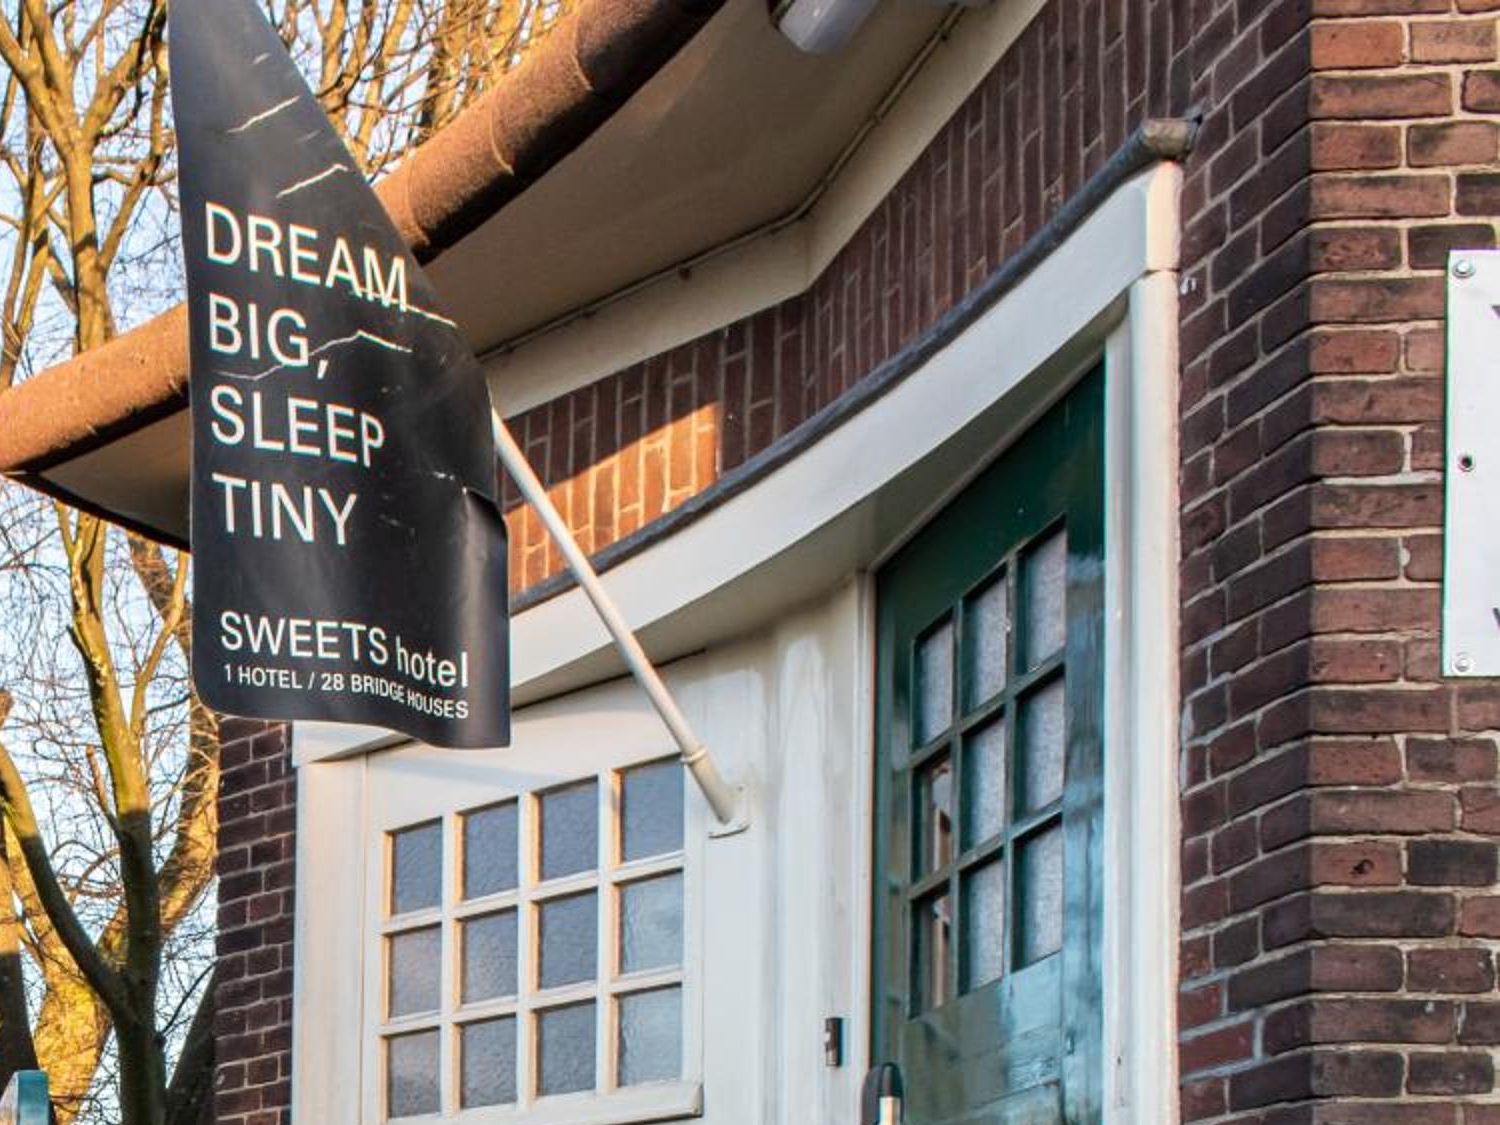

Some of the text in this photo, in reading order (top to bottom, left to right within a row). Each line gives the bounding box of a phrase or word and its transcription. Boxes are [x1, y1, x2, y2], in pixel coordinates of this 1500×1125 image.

[205, 201, 408, 313] DREAM
[209, 293, 329, 379] BIG,
[210, 384, 386, 468] SLEEP
[212, 473, 357, 545] TINY
[220, 611, 469, 688] SWEETS hotel
[224, 664, 469, 719] 1 HOTEL / 28 BRIDGE HOUSES
